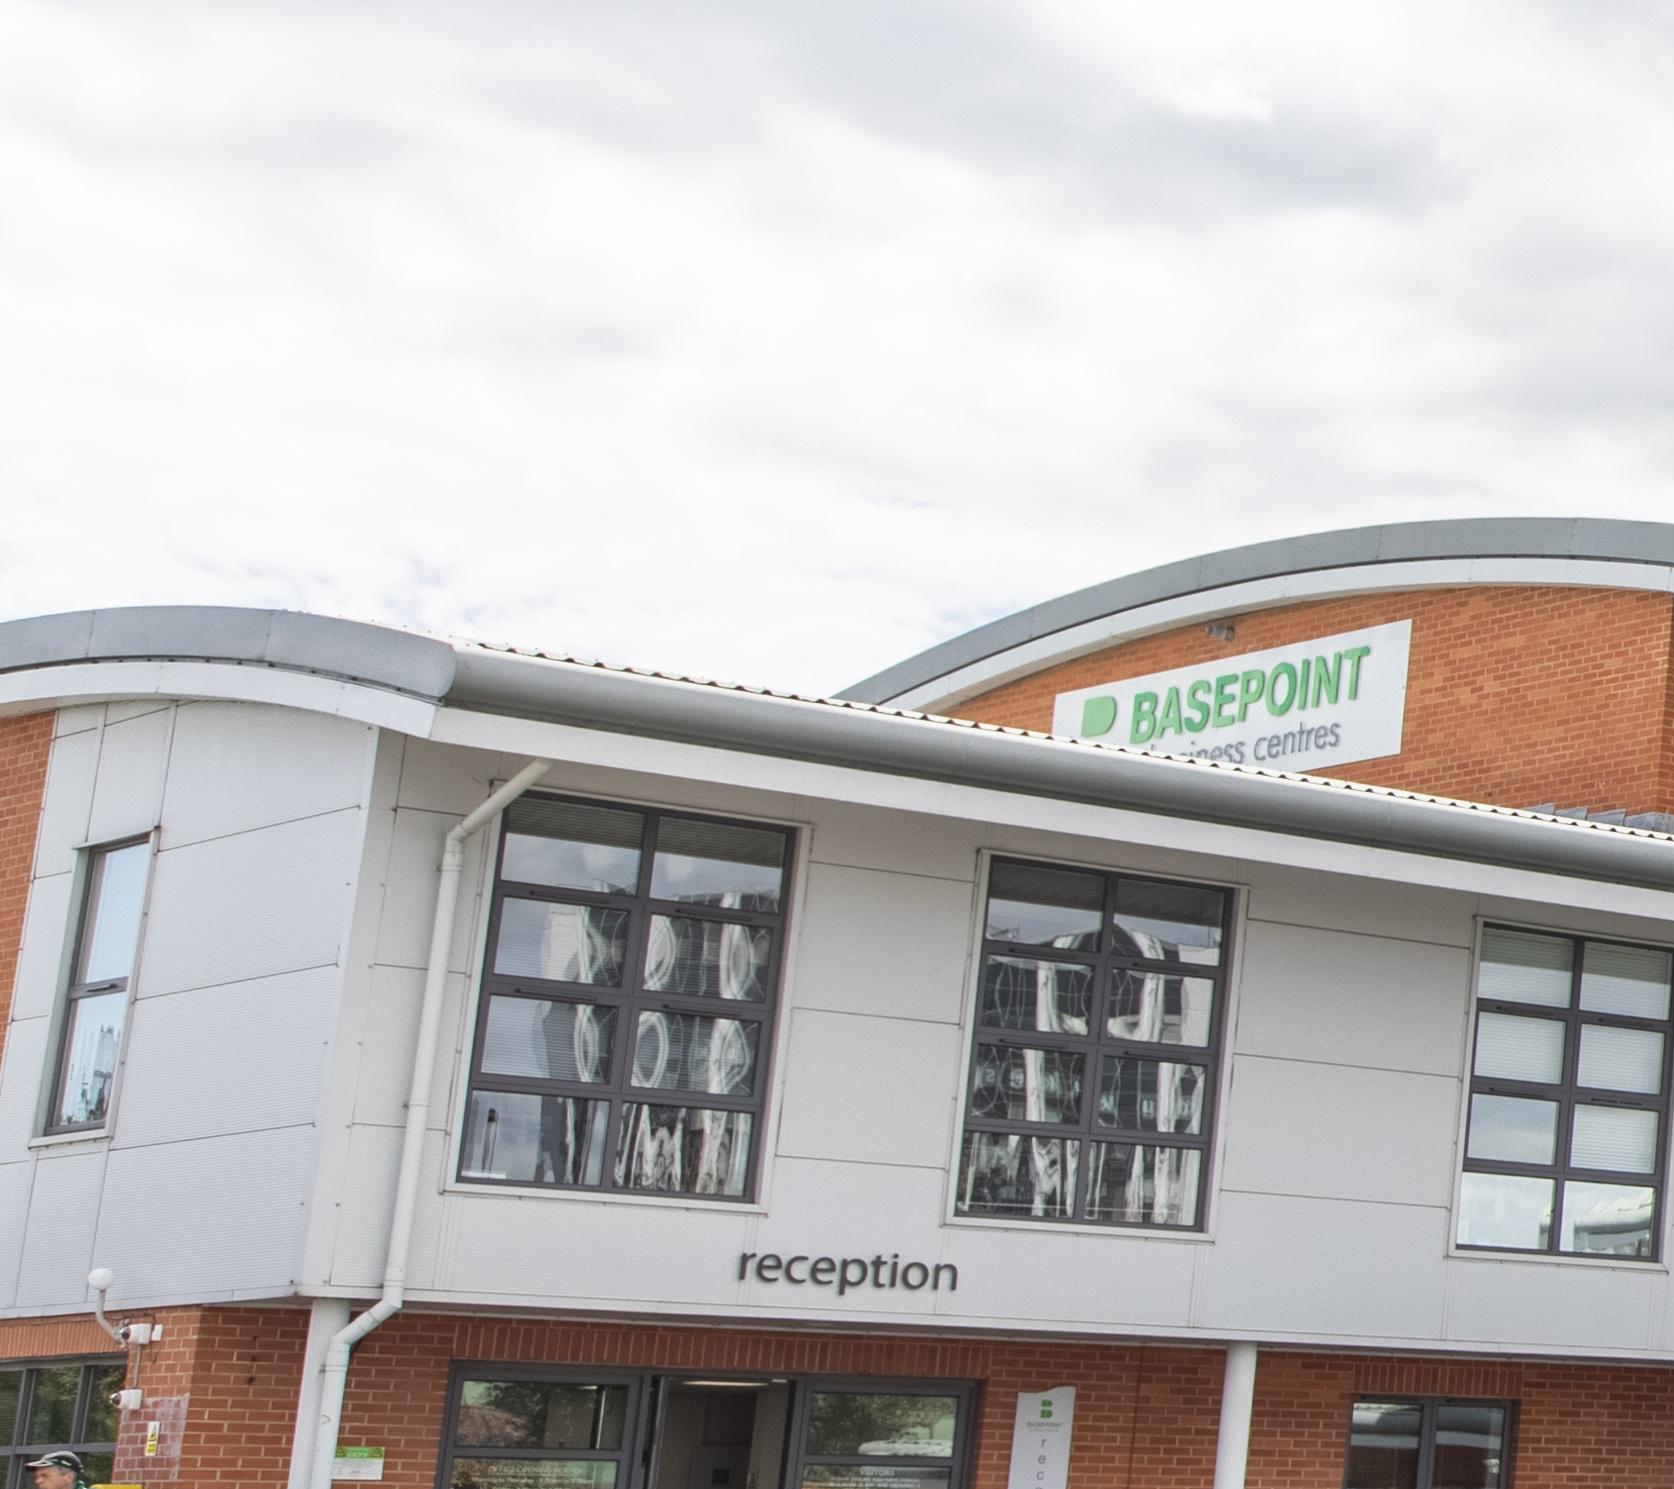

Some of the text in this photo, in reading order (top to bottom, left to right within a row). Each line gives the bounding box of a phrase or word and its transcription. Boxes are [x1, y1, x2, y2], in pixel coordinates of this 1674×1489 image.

[1129, 646, 1371, 744] BASEPOINT
[1150, 721, 1341, 764] iness centres
[737, 1251, 958, 1296] reception
